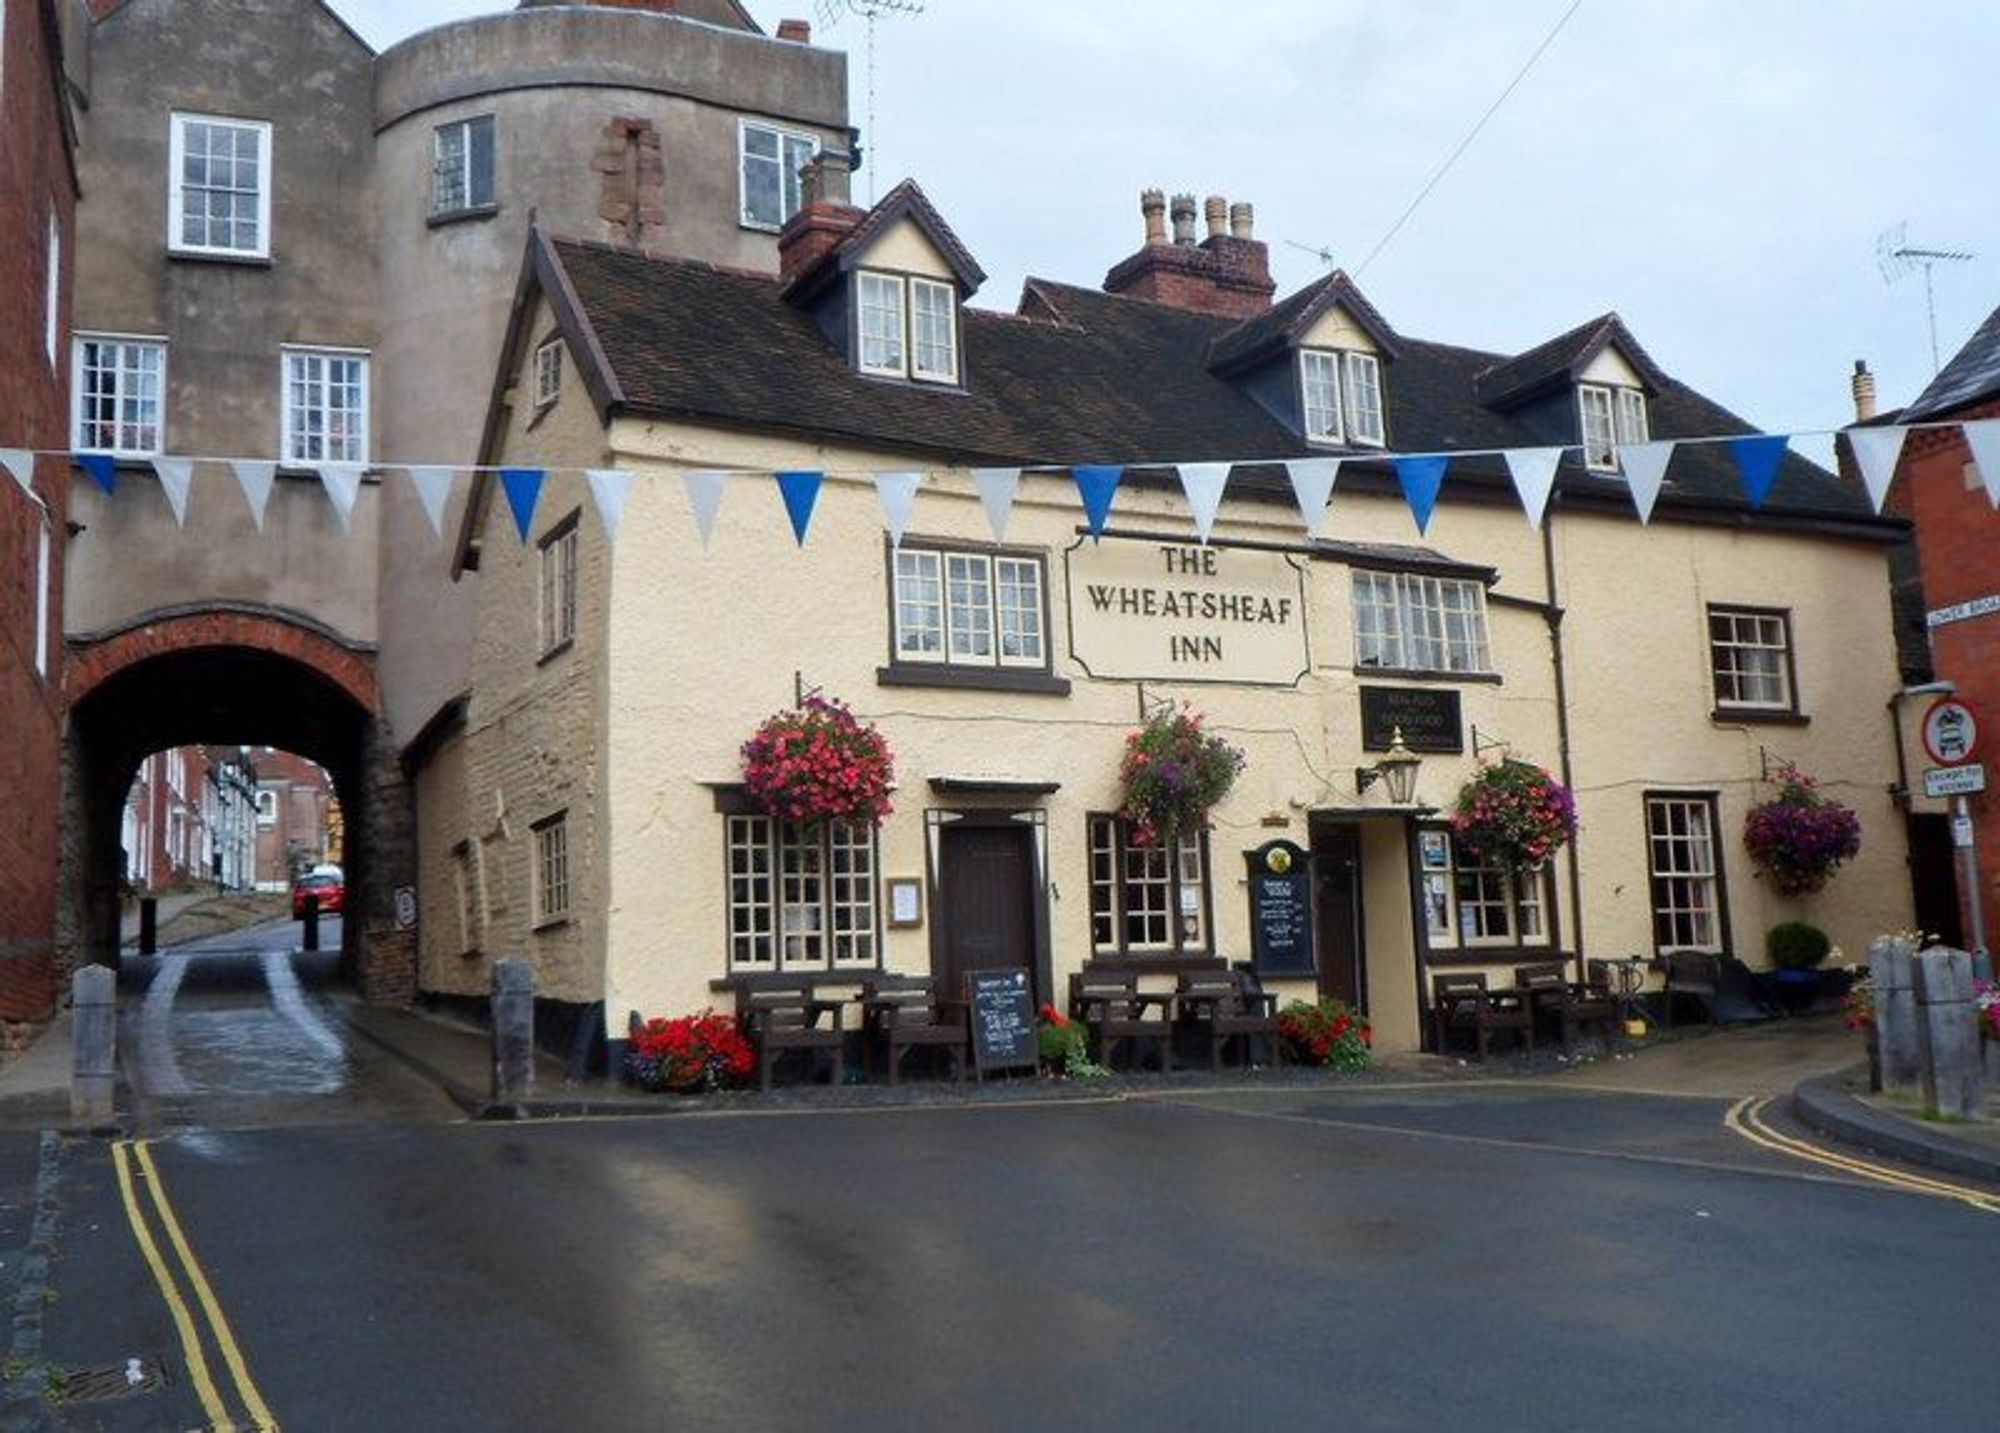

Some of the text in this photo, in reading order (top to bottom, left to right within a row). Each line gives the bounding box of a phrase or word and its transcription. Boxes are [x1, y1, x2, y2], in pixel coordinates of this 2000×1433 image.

[1160, 546, 1218, 576] THE
[1087, 584, 1292, 625] WHEATSHEAF
[1170, 635, 1223, 662] INN
